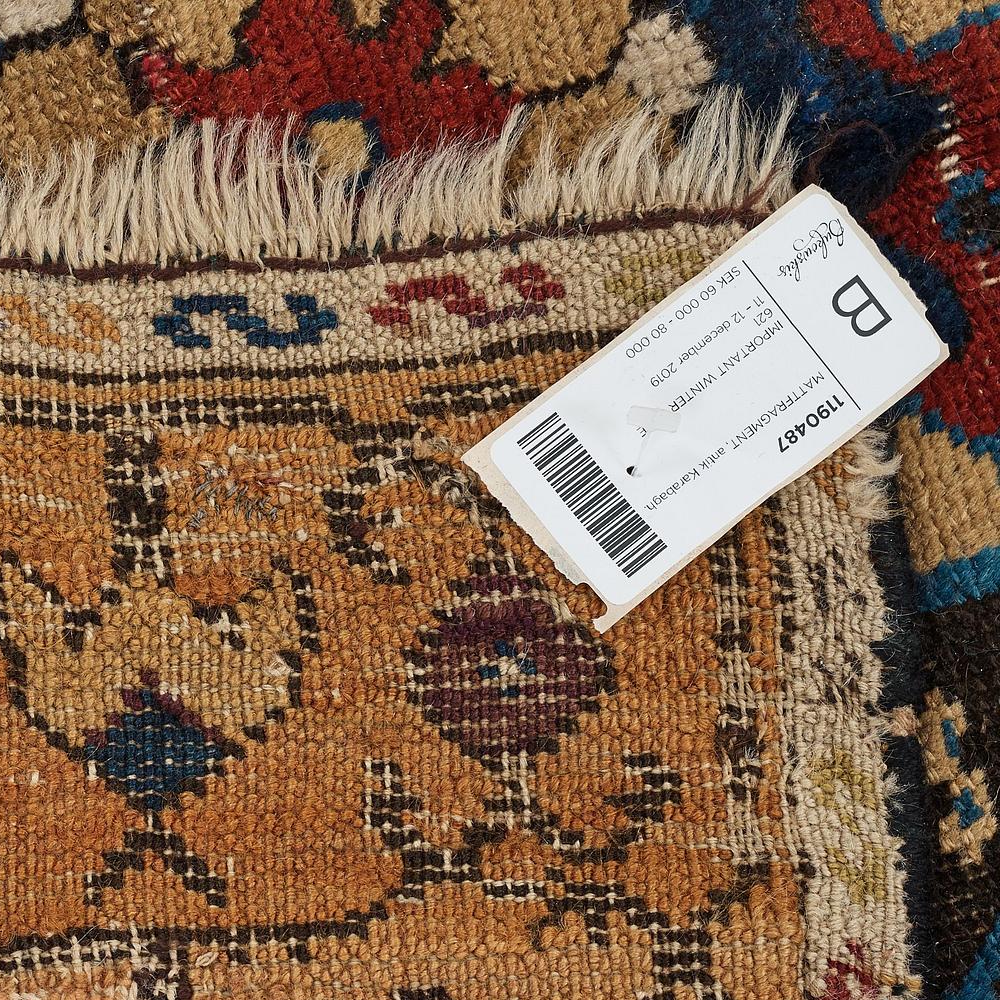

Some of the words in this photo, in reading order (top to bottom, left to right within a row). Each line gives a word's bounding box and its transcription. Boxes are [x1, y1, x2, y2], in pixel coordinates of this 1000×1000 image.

[777, 218, 845, 283] Bukowskis
[715, 266, 741, 289] SEK
[699, 284, 717, 301] 60
[752, 295, 765, 308] 11
[674, 298, 700, 321] 000
[730, 311, 746, 324] 12
[753, 307, 773, 327] 621
[831, 274, 893, 338] B
[650, 323, 668, 339] 80
[678, 320, 731, 365] december
[625, 336, 651, 359] 000
[717, 319, 784, 377] IMPORTANT
[650, 362, 678, 388] 2019
[668, 373, 718, 413] WINTER
[725, 371, 825, 450] MATTFRAGMENT,
[777, 394, 845, 454] 1190487
[698, 447, 726, 470] antik
[643, 467, 701, 511] Karabagh.
